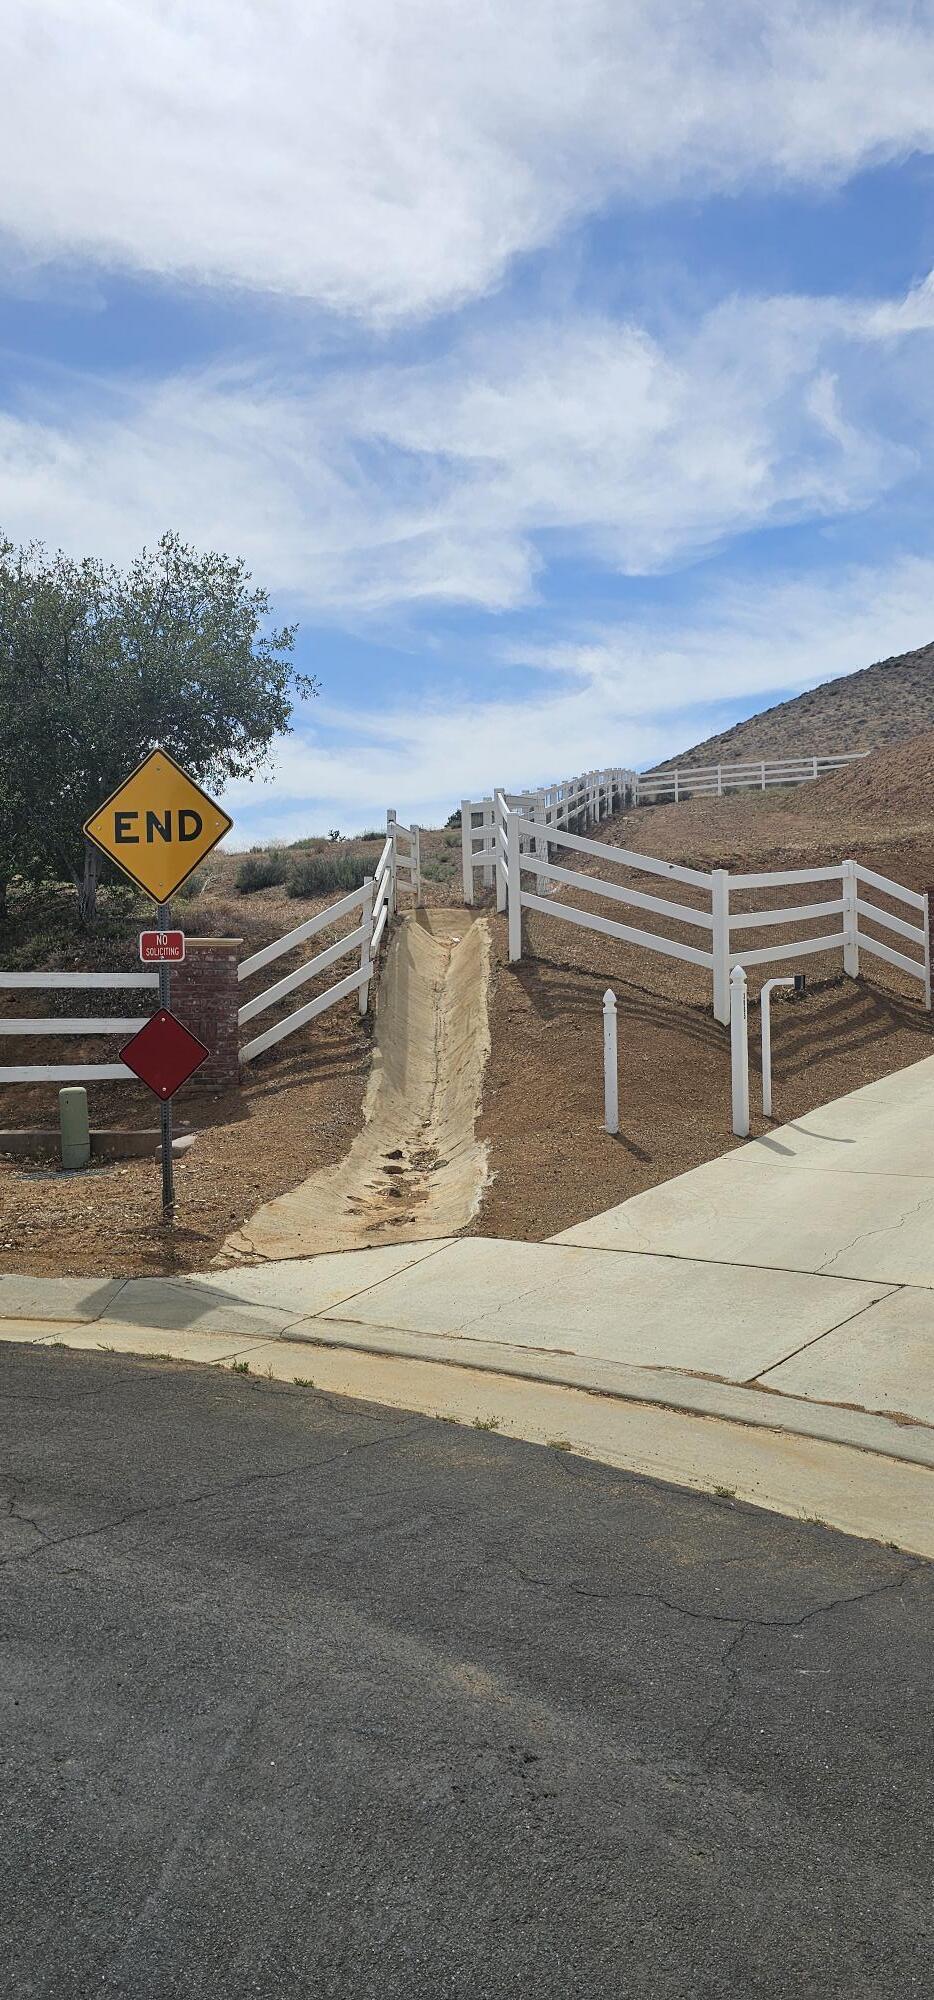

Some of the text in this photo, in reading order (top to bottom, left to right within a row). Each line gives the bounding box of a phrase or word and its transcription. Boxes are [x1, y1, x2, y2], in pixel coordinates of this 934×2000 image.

[114, 809, 203, 844] END
[156, 935, 168, 946] NO
[145, 946, 180, 957] SOLICITING
